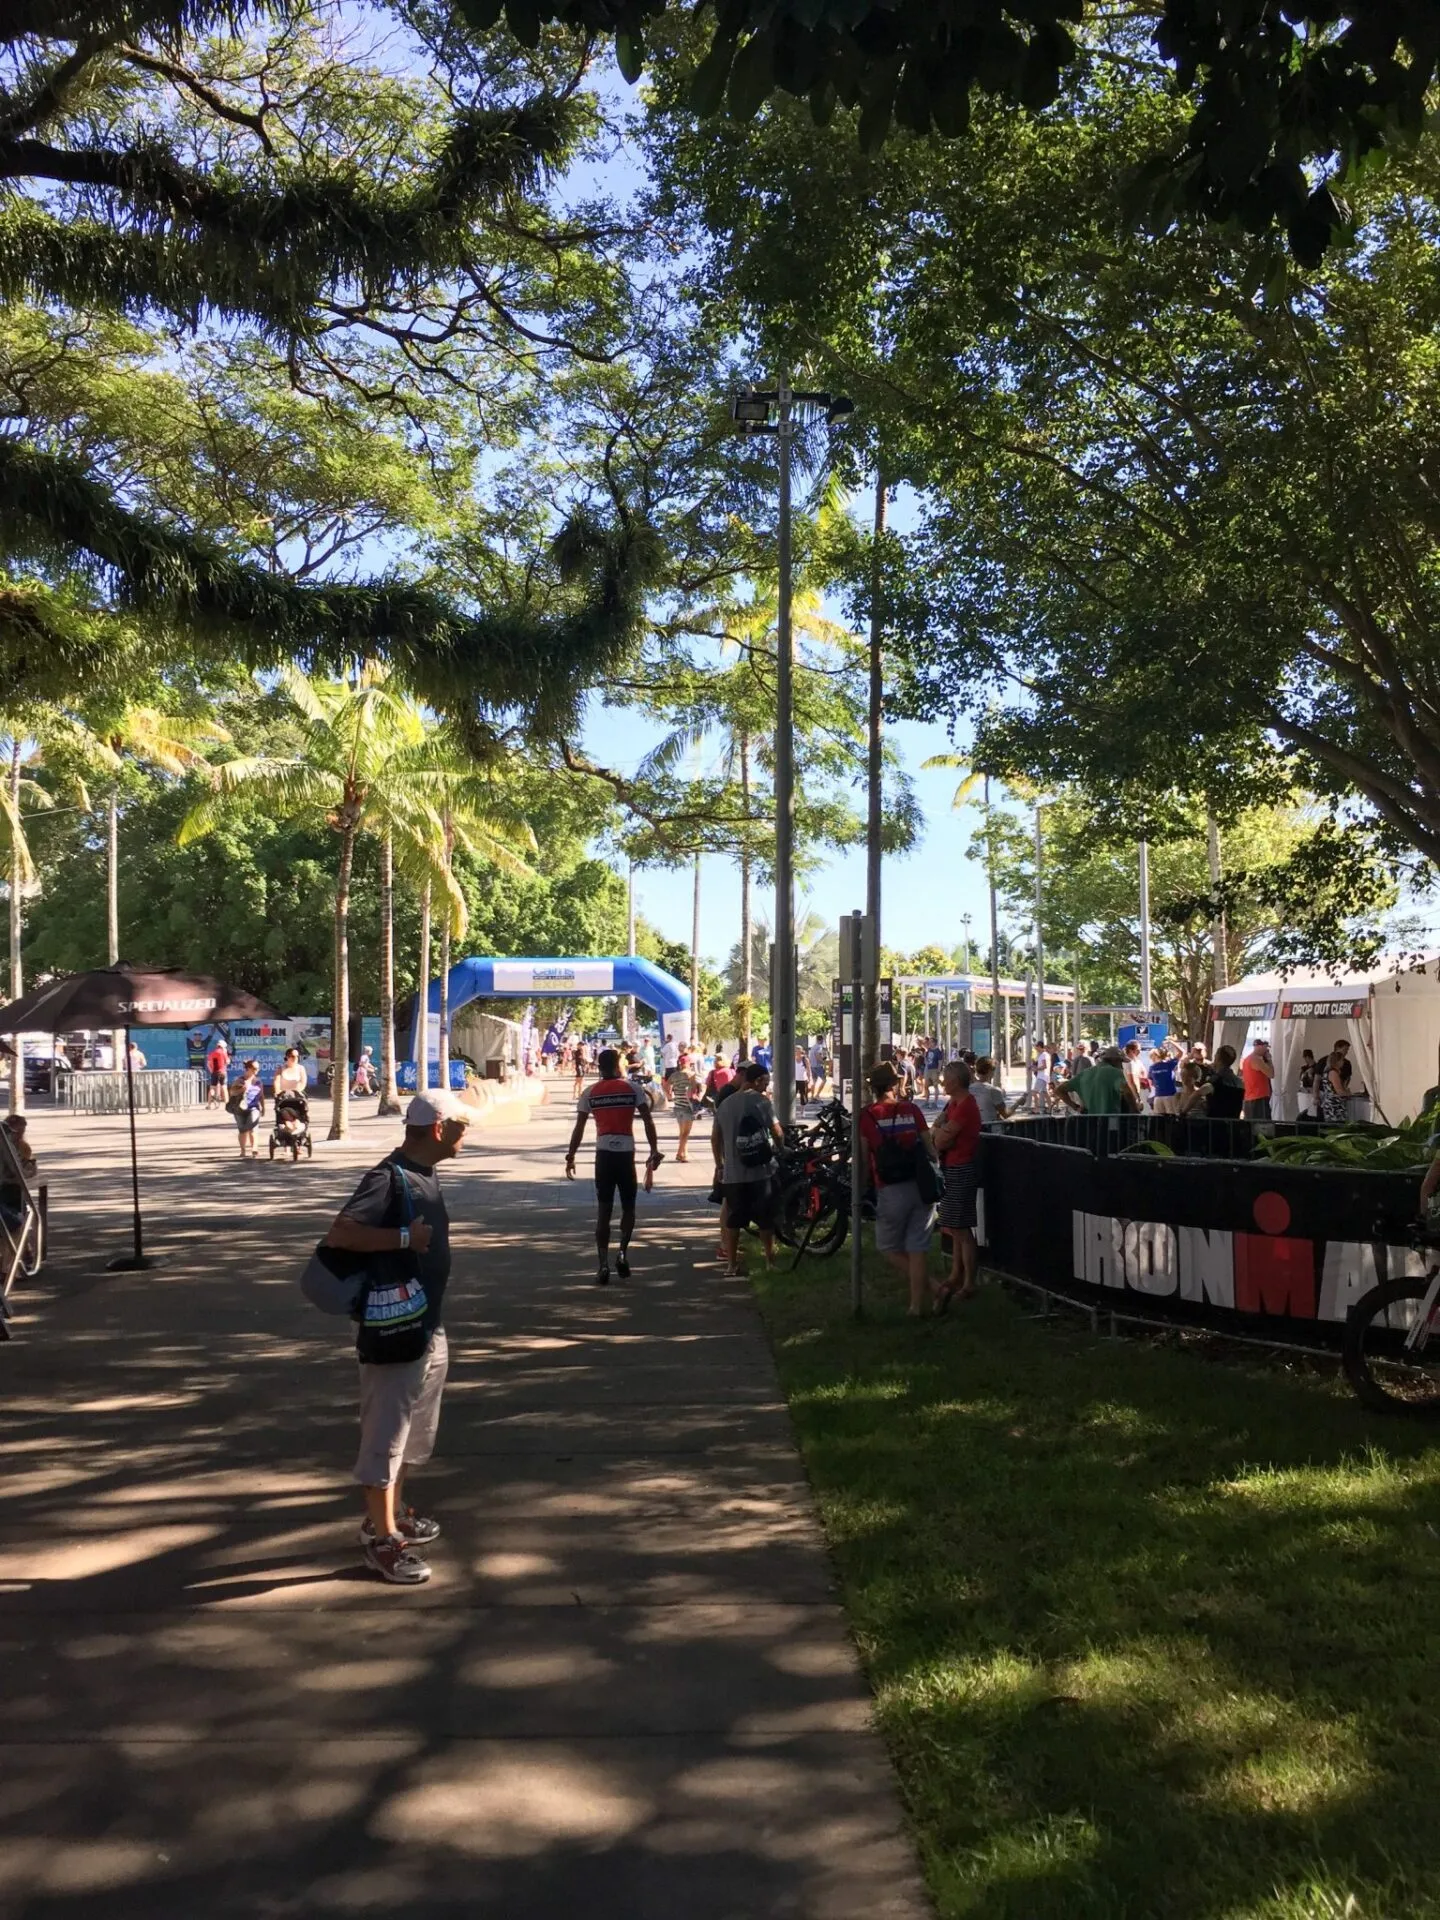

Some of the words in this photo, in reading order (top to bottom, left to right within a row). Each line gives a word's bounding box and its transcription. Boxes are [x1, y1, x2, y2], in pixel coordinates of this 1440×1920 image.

[532, 980, 575, 989] EXPO
[117, 997, 217, 1014] SPECIALIZED
[1225, 1005, 1265, 1017] INFORMATION
[1291, 1002, 1312, 1015] DROP
[1313, 1002, 1330, 1014] OUT
[1330, 1002, 1353, 1014] CLERK
[234, 1024, 287, 1037] IRONMAN
[1072, 1191, 1440, 1332] IRONMAN
